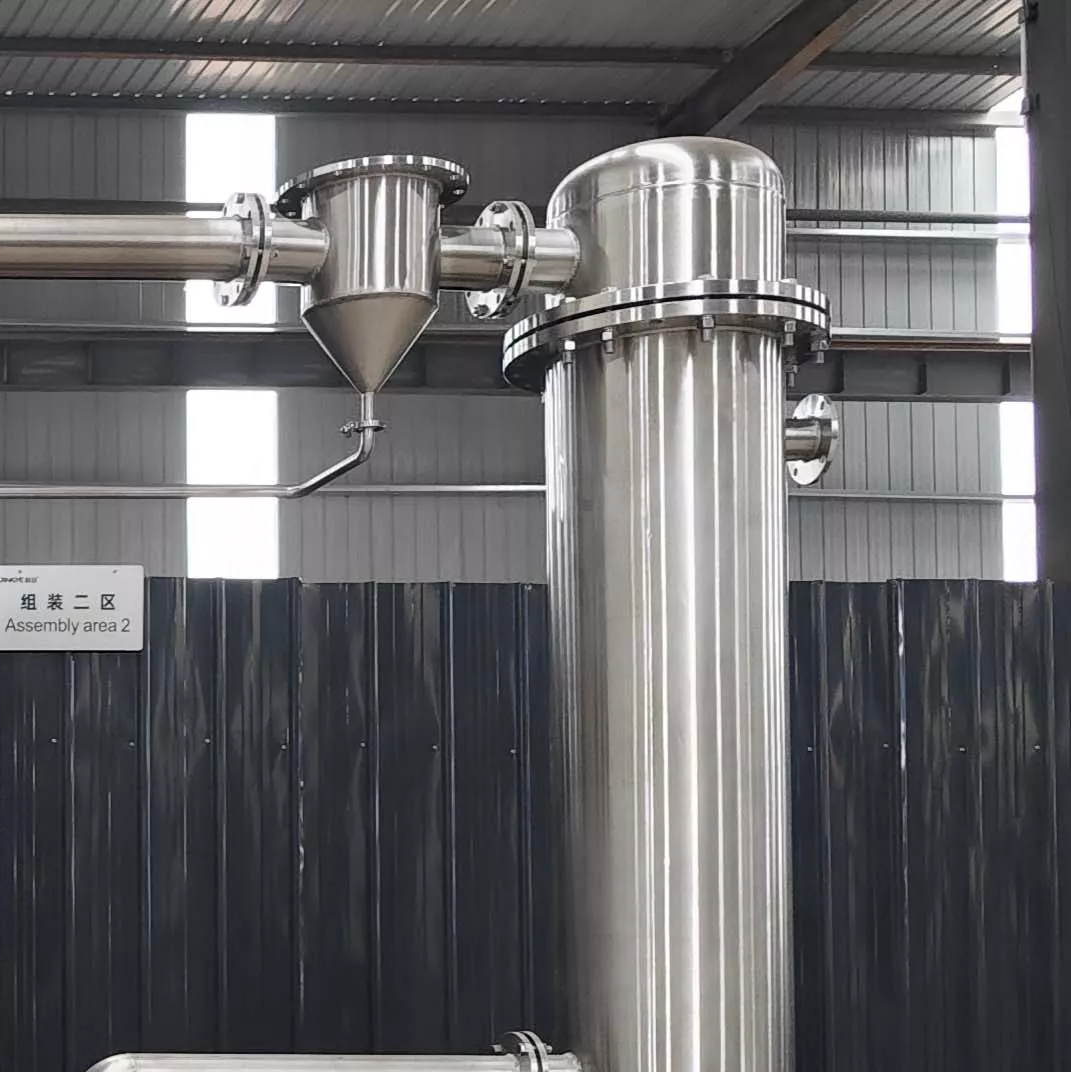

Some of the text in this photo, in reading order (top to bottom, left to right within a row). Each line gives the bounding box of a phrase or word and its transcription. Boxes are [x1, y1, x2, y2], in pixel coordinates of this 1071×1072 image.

[20, 593, 116, 611] 组装二区
[5, 618, 130, 636] Assembly area 2
